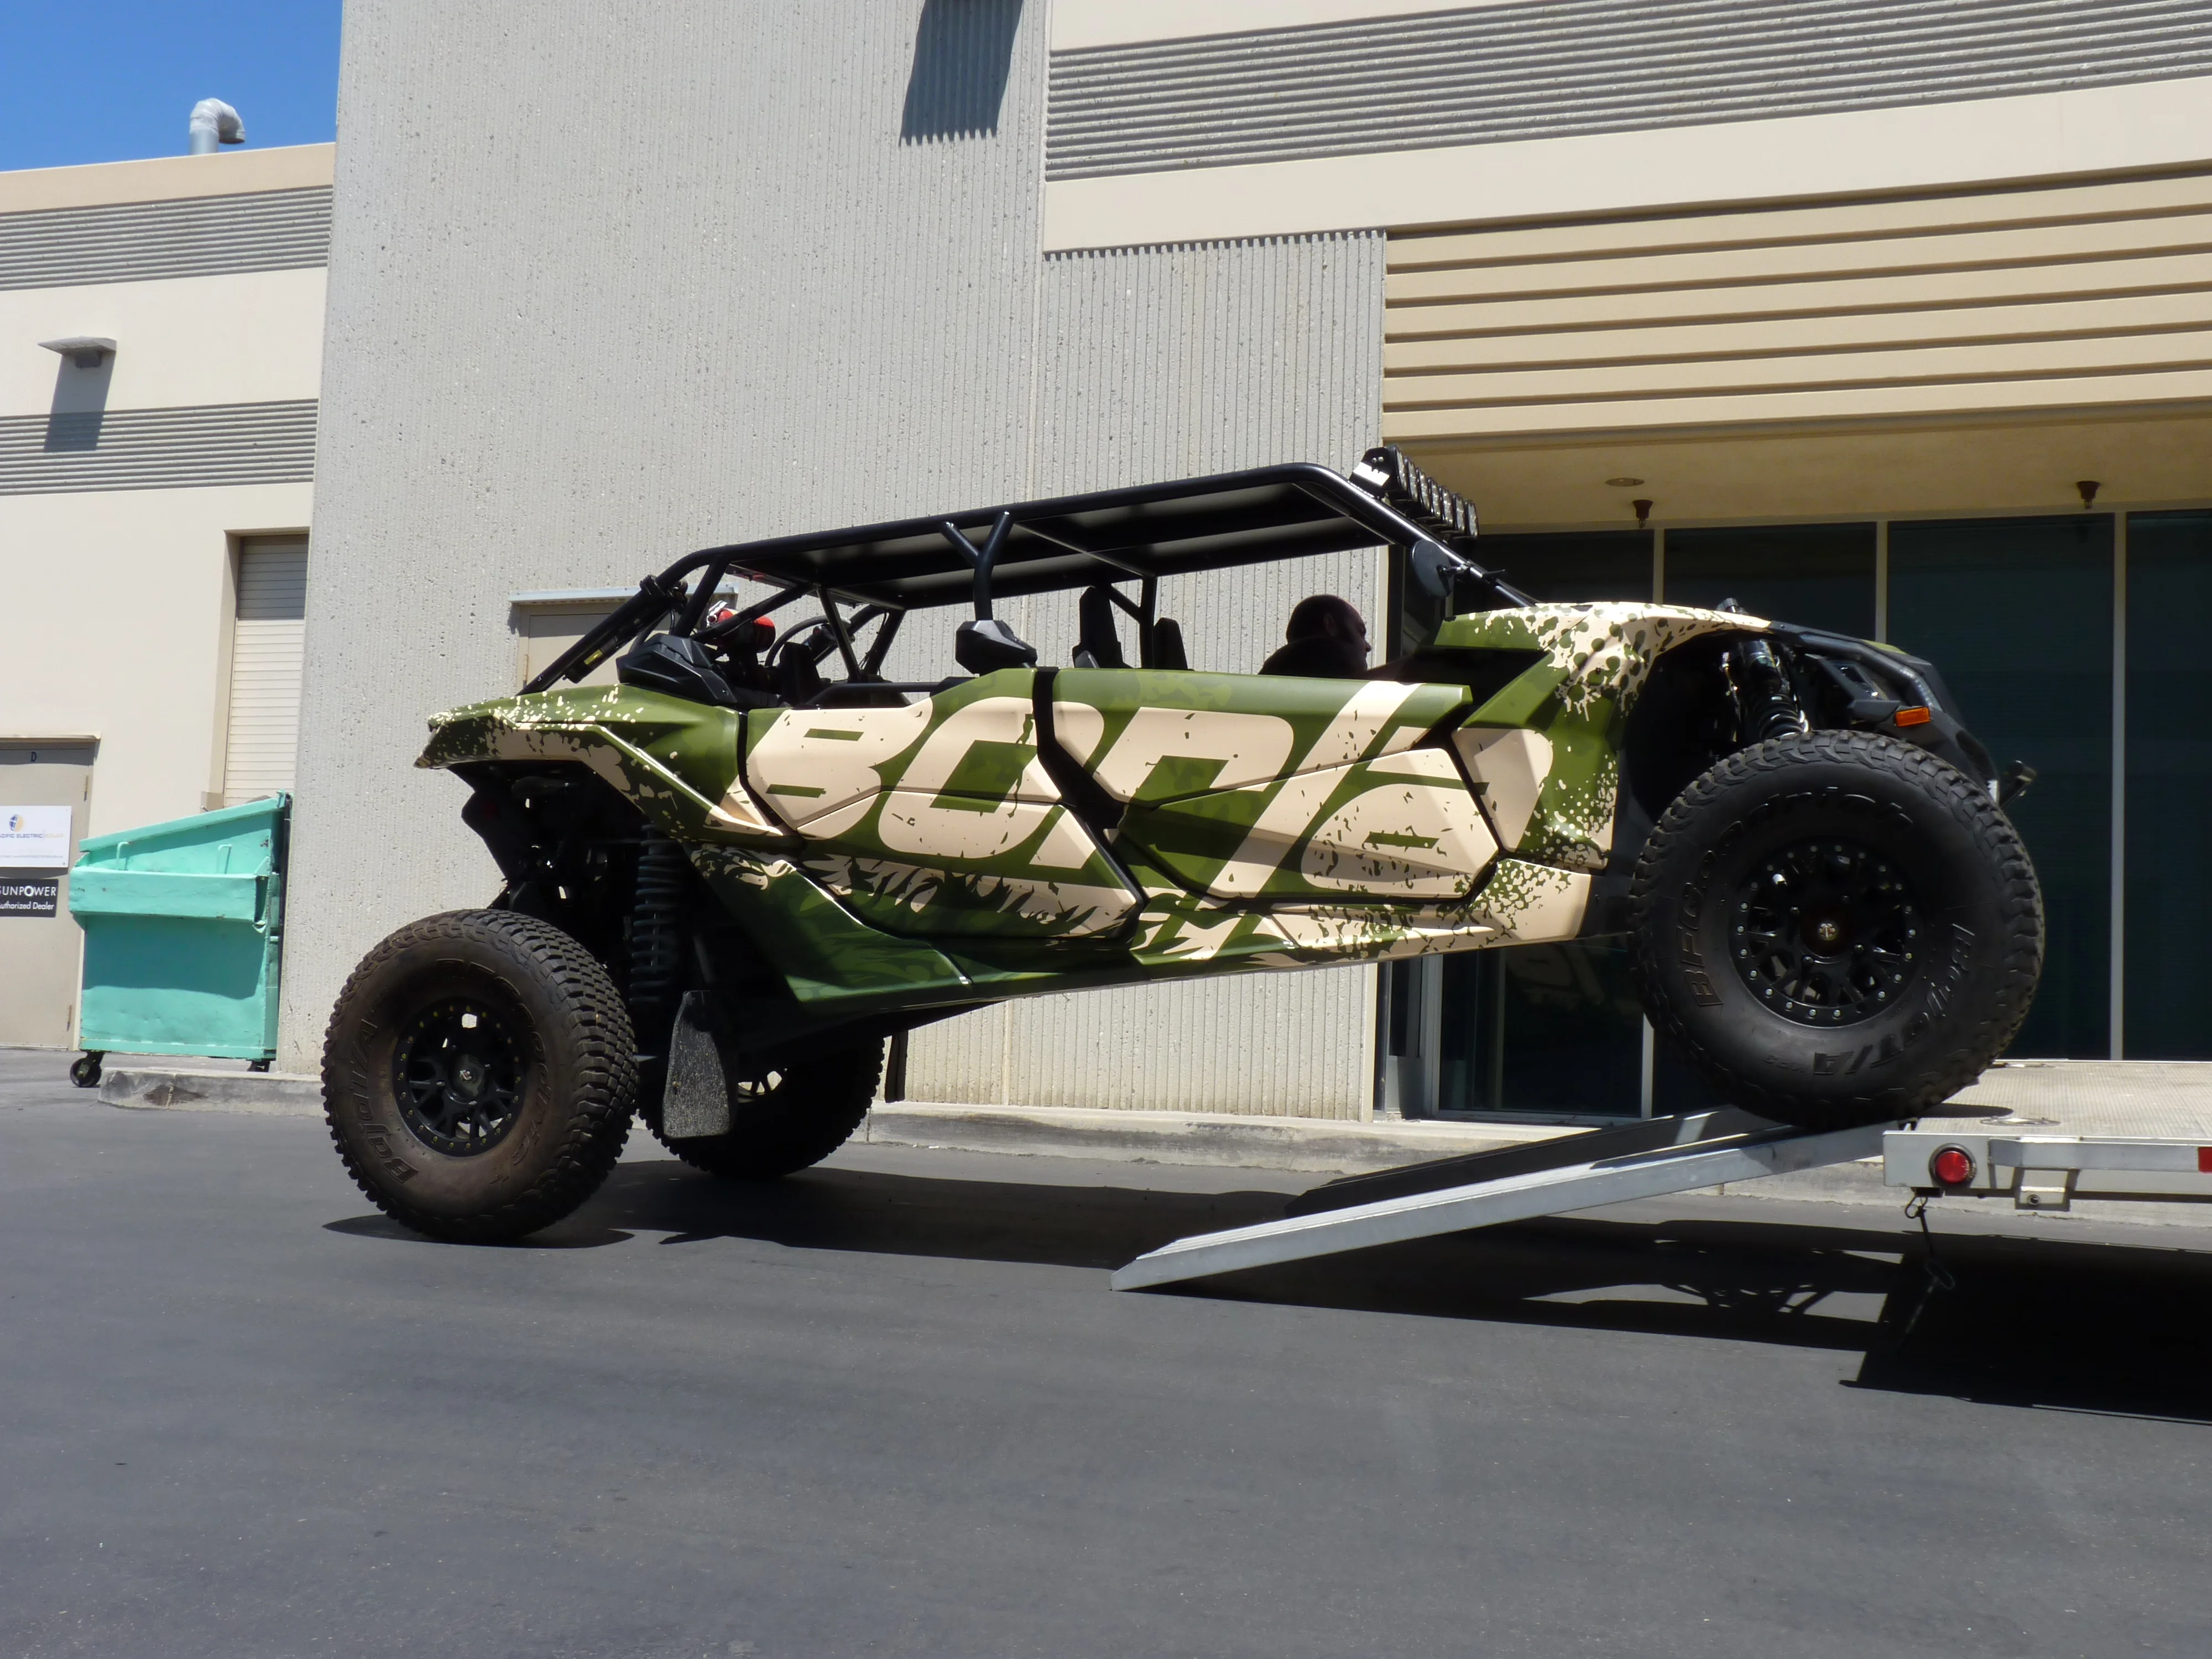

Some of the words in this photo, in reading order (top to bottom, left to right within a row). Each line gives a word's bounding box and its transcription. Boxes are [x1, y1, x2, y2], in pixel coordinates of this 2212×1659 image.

[31, 752, 37, 763] D
[0, 885, 56, 896] UNPOWER
[0, 900, 32, 910] uthorized
[33, 901, 54, 910] Dealer
